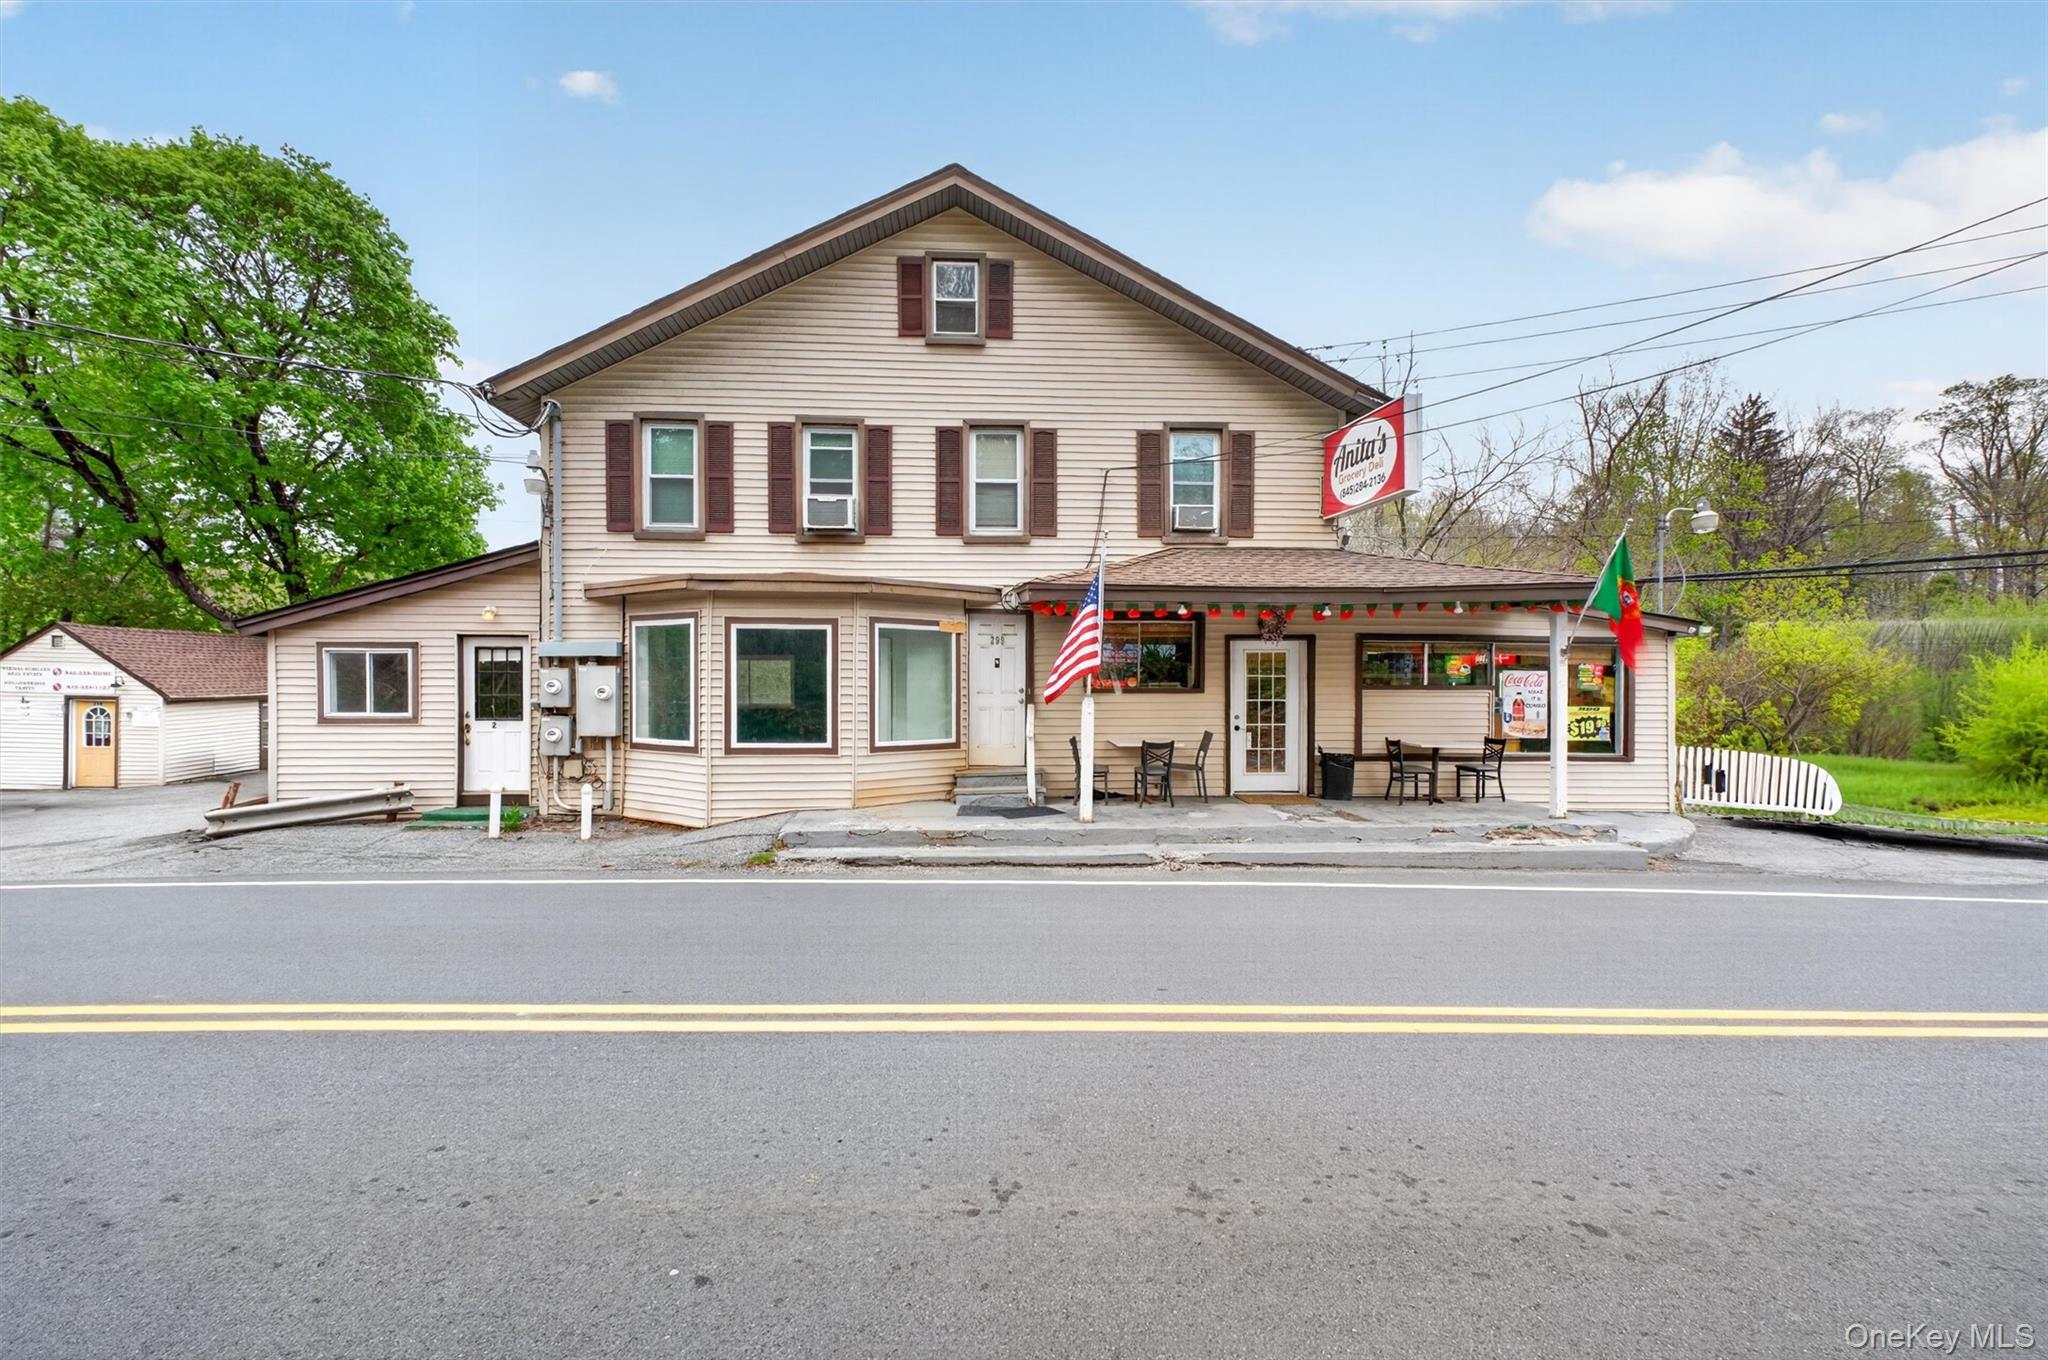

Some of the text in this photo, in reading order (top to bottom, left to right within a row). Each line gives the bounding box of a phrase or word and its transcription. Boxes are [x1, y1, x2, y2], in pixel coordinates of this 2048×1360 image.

[1334, 425, 1387, 478] Anita's
[1338, 456, 1385, 485] Grocery Deli
[990, 636, 1005, 646] 299
[492, 721, 498, 729] 2
